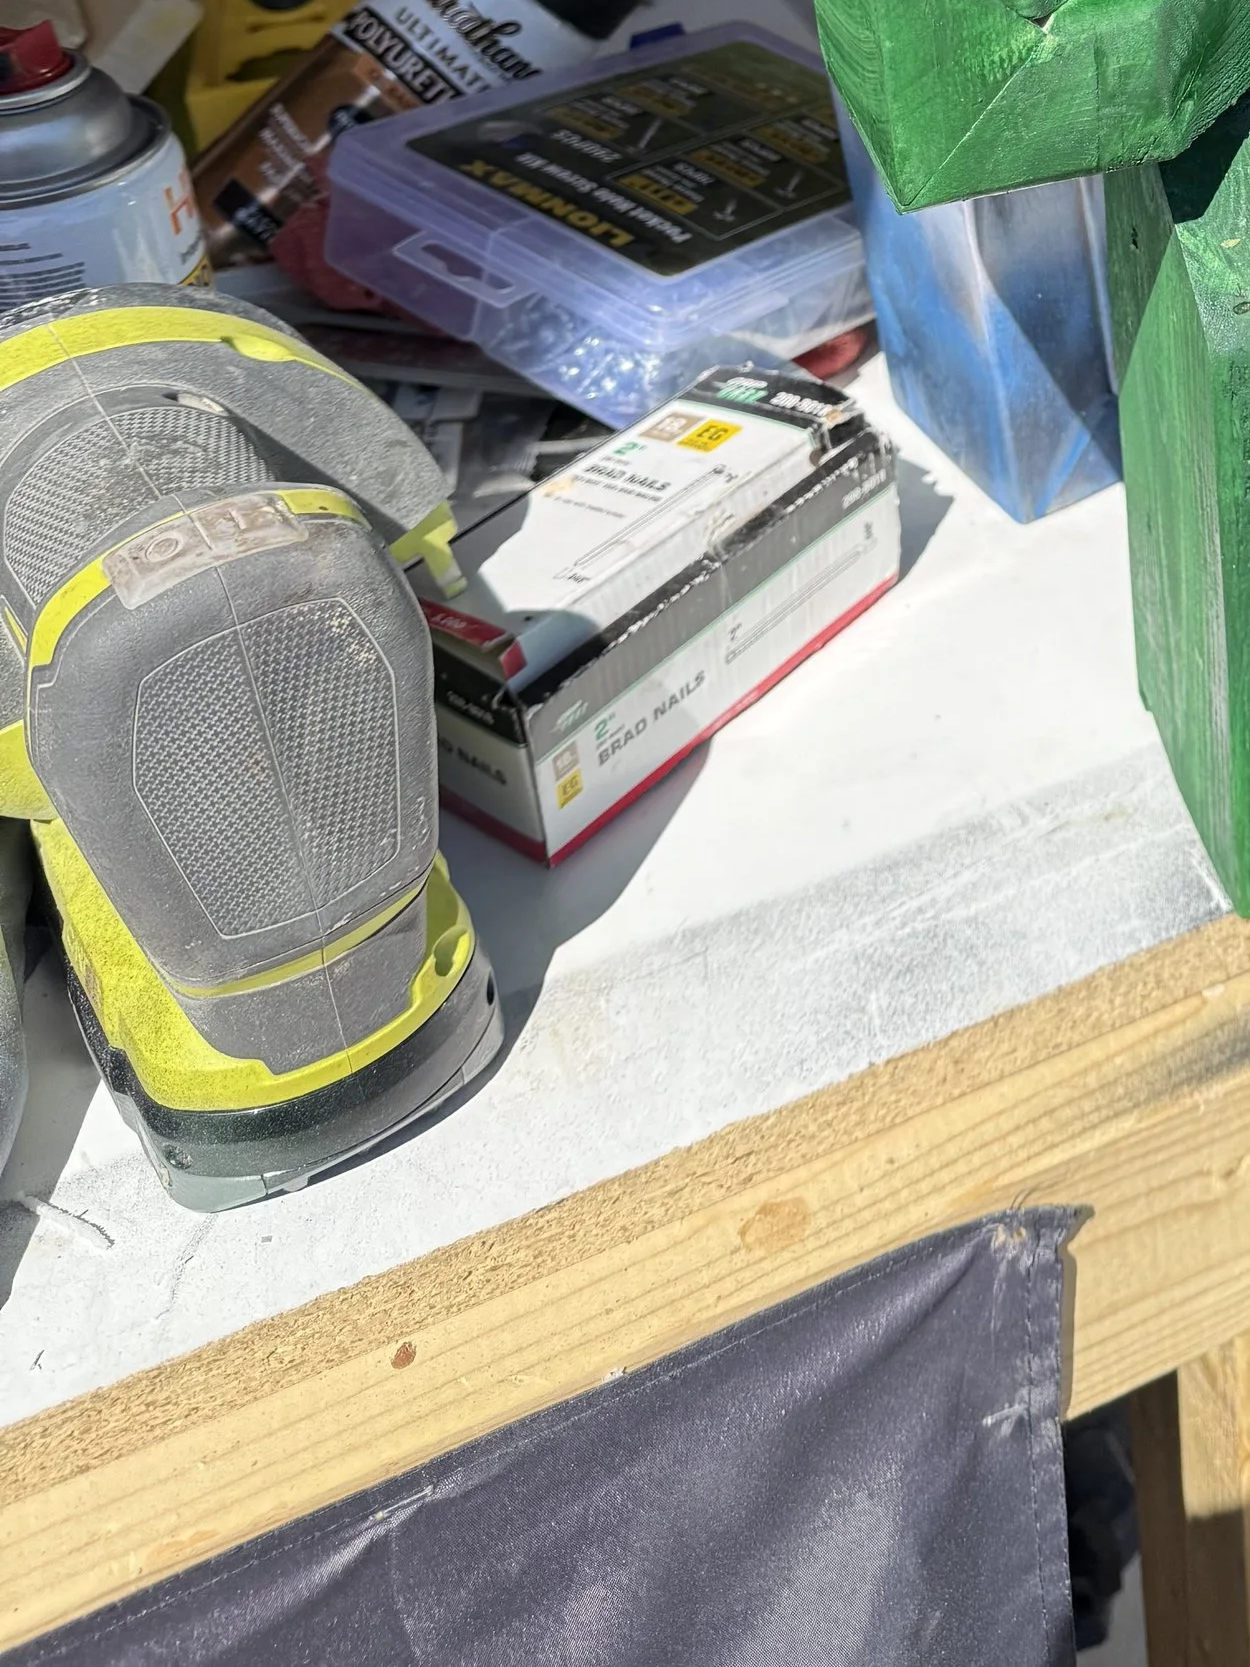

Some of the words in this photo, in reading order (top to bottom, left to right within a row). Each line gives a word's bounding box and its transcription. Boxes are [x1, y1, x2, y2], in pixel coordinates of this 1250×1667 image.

[394, 6, 491, 94] ULTIMAT
[460, 158, 637, 248] LIONMAX
[598, 718, 648, 768] BRAD
[653, 669, 707, 724] NAILS
